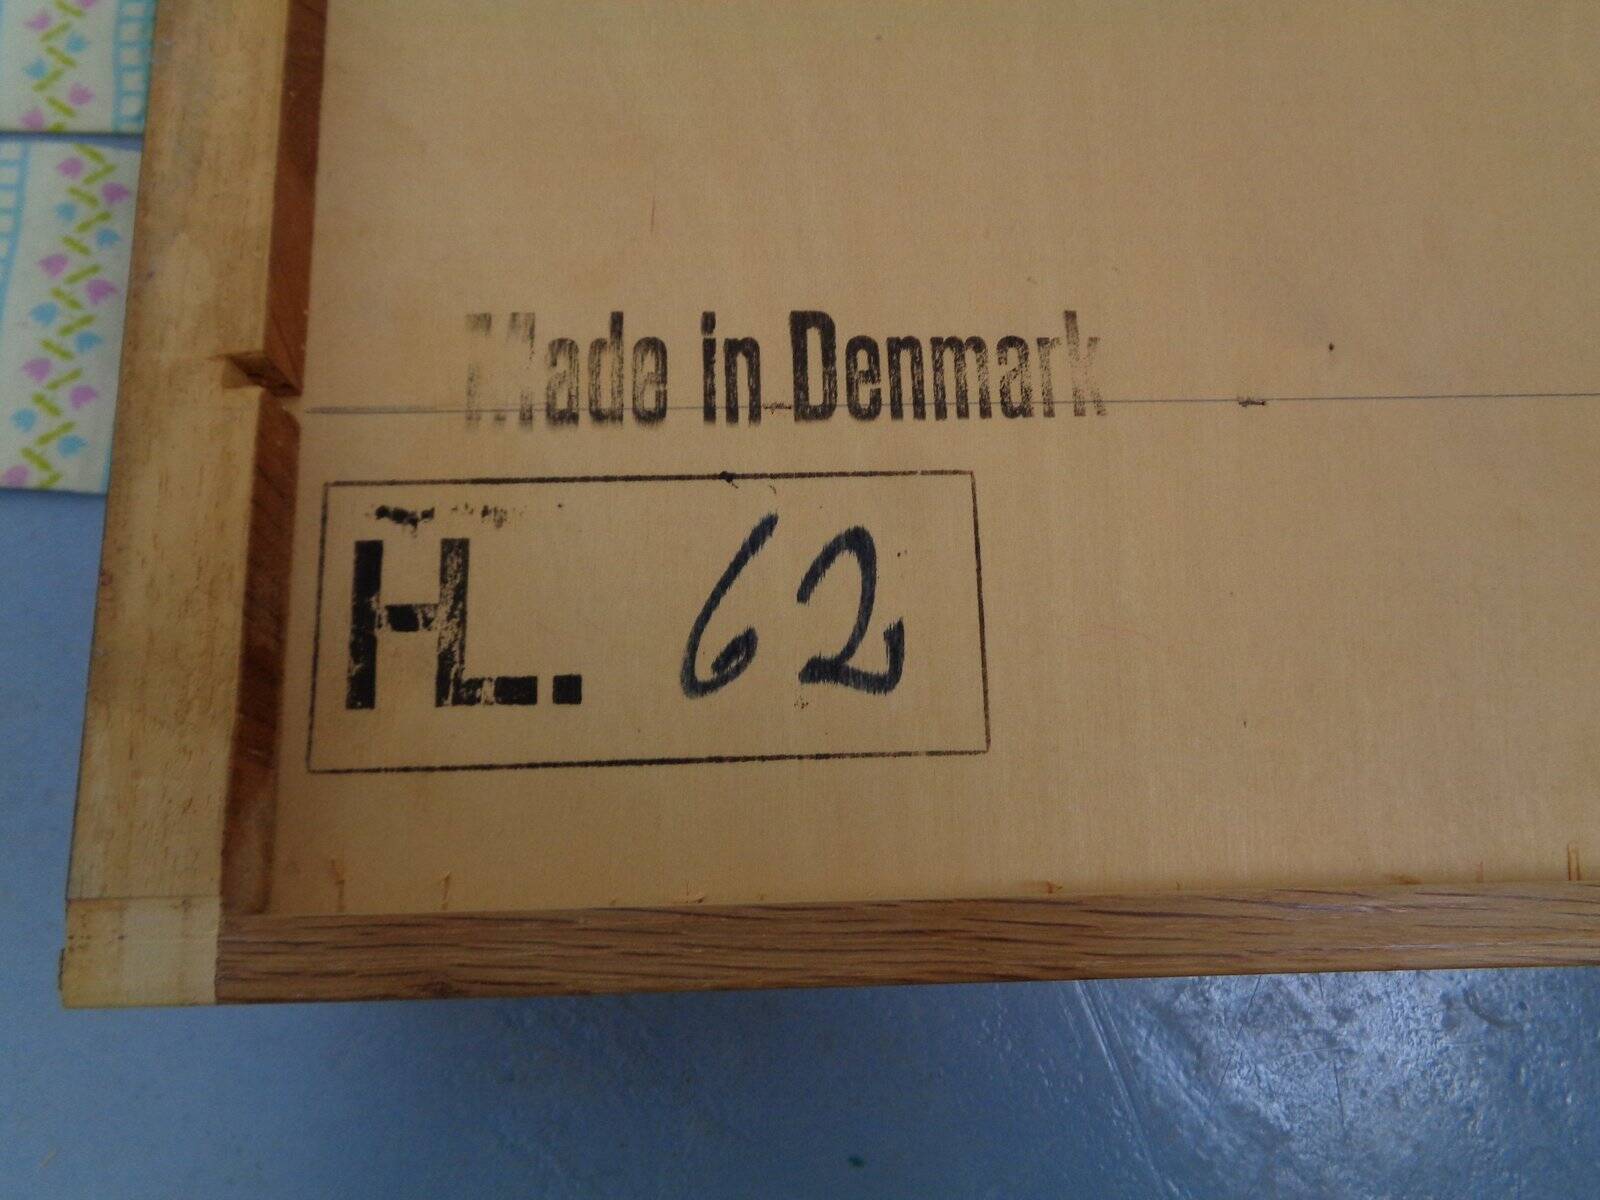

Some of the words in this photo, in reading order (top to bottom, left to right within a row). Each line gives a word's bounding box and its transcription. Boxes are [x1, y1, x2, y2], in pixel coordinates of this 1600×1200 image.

[701, 311, 761, 425] in
[789, 309, 1106, 422] Denmark
[679, 512, 905, 700] 62
